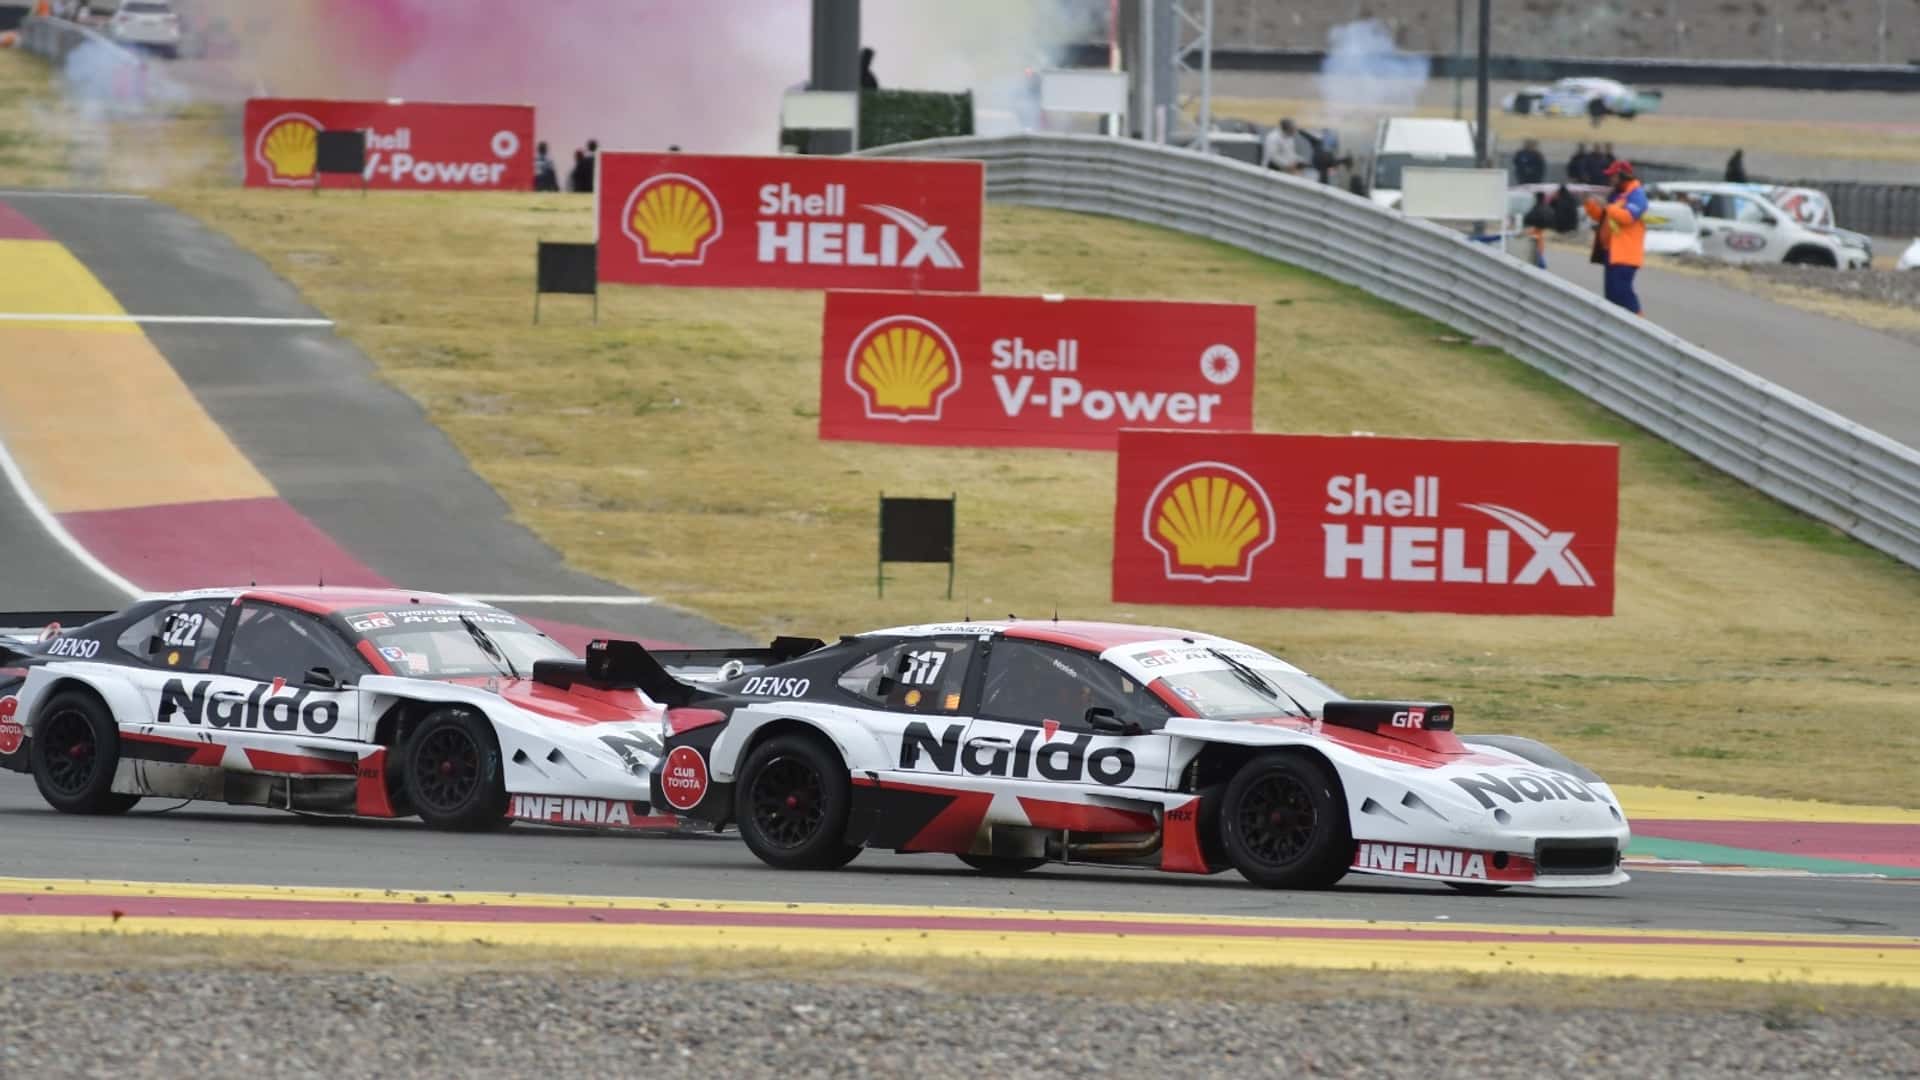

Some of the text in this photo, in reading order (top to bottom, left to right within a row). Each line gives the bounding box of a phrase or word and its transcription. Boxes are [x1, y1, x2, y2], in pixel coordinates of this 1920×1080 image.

[357, 127, 410, 150] hell
[758, 183, 846, 217] Shell
[756, 204, 965, 269] HELIX
[990, 338, 1078, 372] Shell
[992, 374, 1221, 423] V-Power
[1325, 474, 1439, 518] Shell
[1321, 502, 1596, 588] HELIX
[47, 637, 101, 659] DENSO
[901, 650, 947, 686] 117
[740, 677, 811, 698] DENSO
[157, 678, 340, 735] Naldo
[1392, 711, 1425, 729] GR
[899, 720, 1136, 786] Naldo
[667, 777, 701, 790] TOYOTA
[673, 766, 697, 778] CLUB
[514, 795, 630, 825] INFINIA
[1359, 843, 1488, 879] INFINIA
